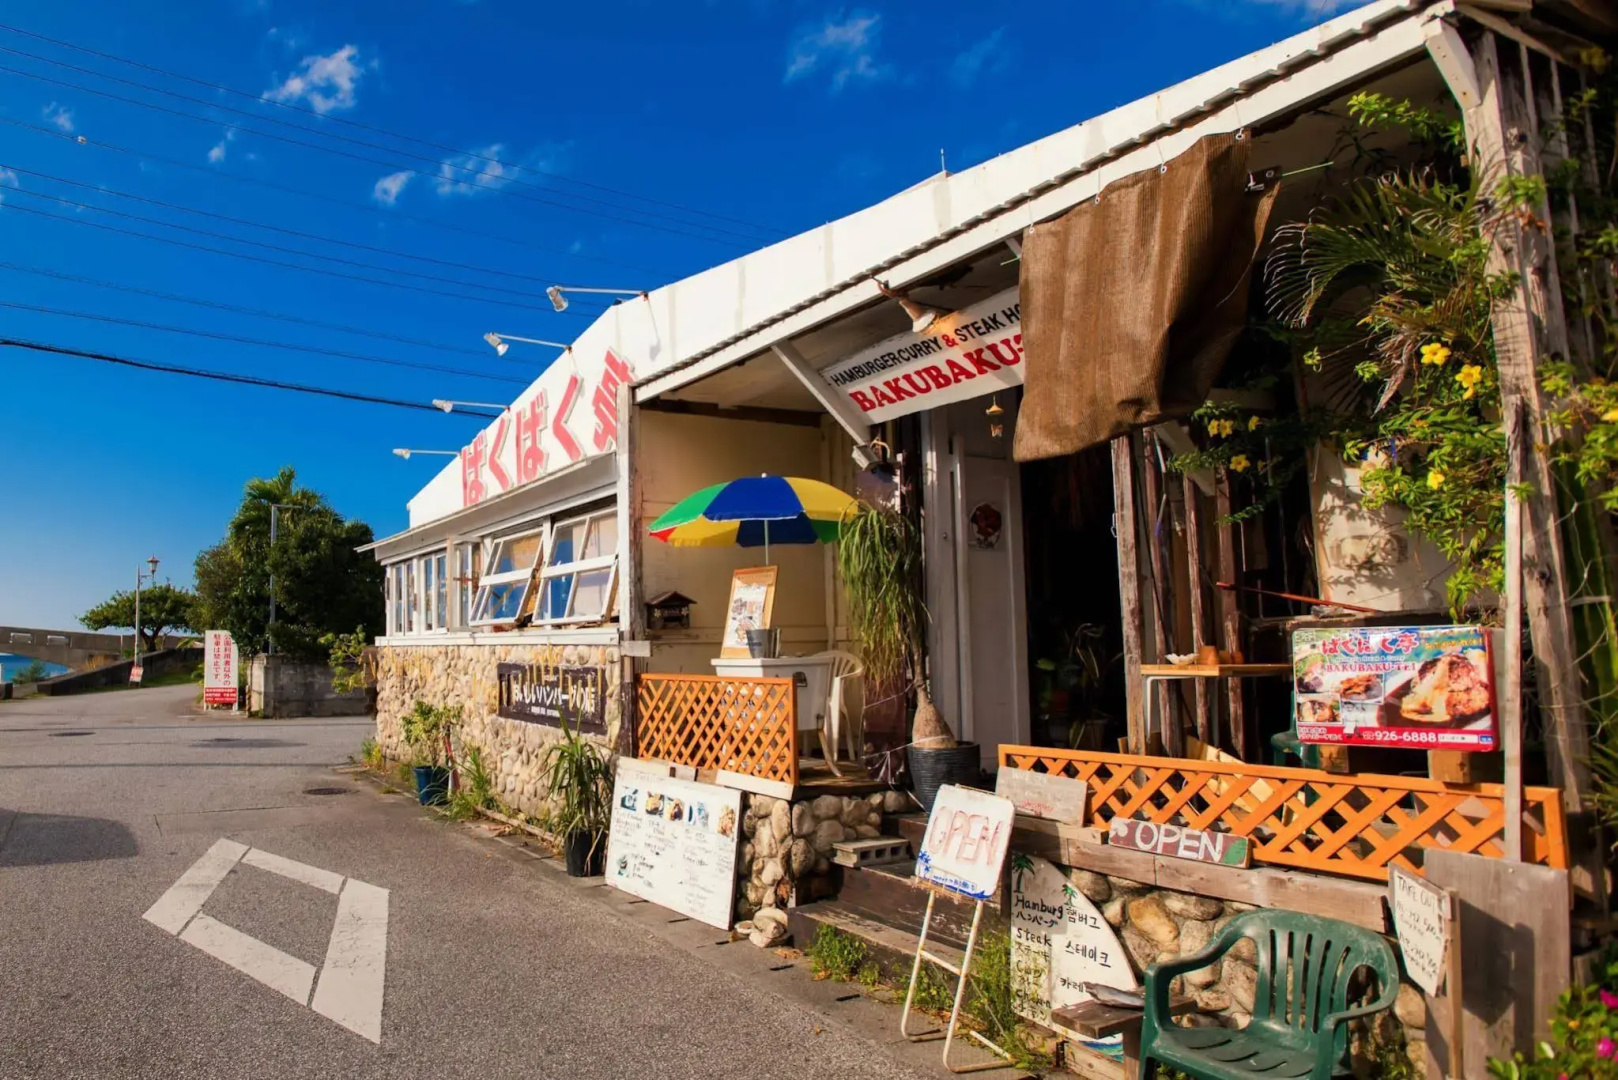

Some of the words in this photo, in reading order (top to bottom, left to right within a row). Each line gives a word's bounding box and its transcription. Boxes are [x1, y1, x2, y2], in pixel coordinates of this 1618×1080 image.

[942, 333, 958, 349] &
[954, 313, 1006, 342] STEAK
[1374, 730, 1437, 743] 926-6888
[1135, 821, 1224, 863] OPEN
[1015, 895, 1063, 919] Hamburg
[1016, 928, 1052, 947] Steak
[1065, 941, 1112, 968] 스테이크
